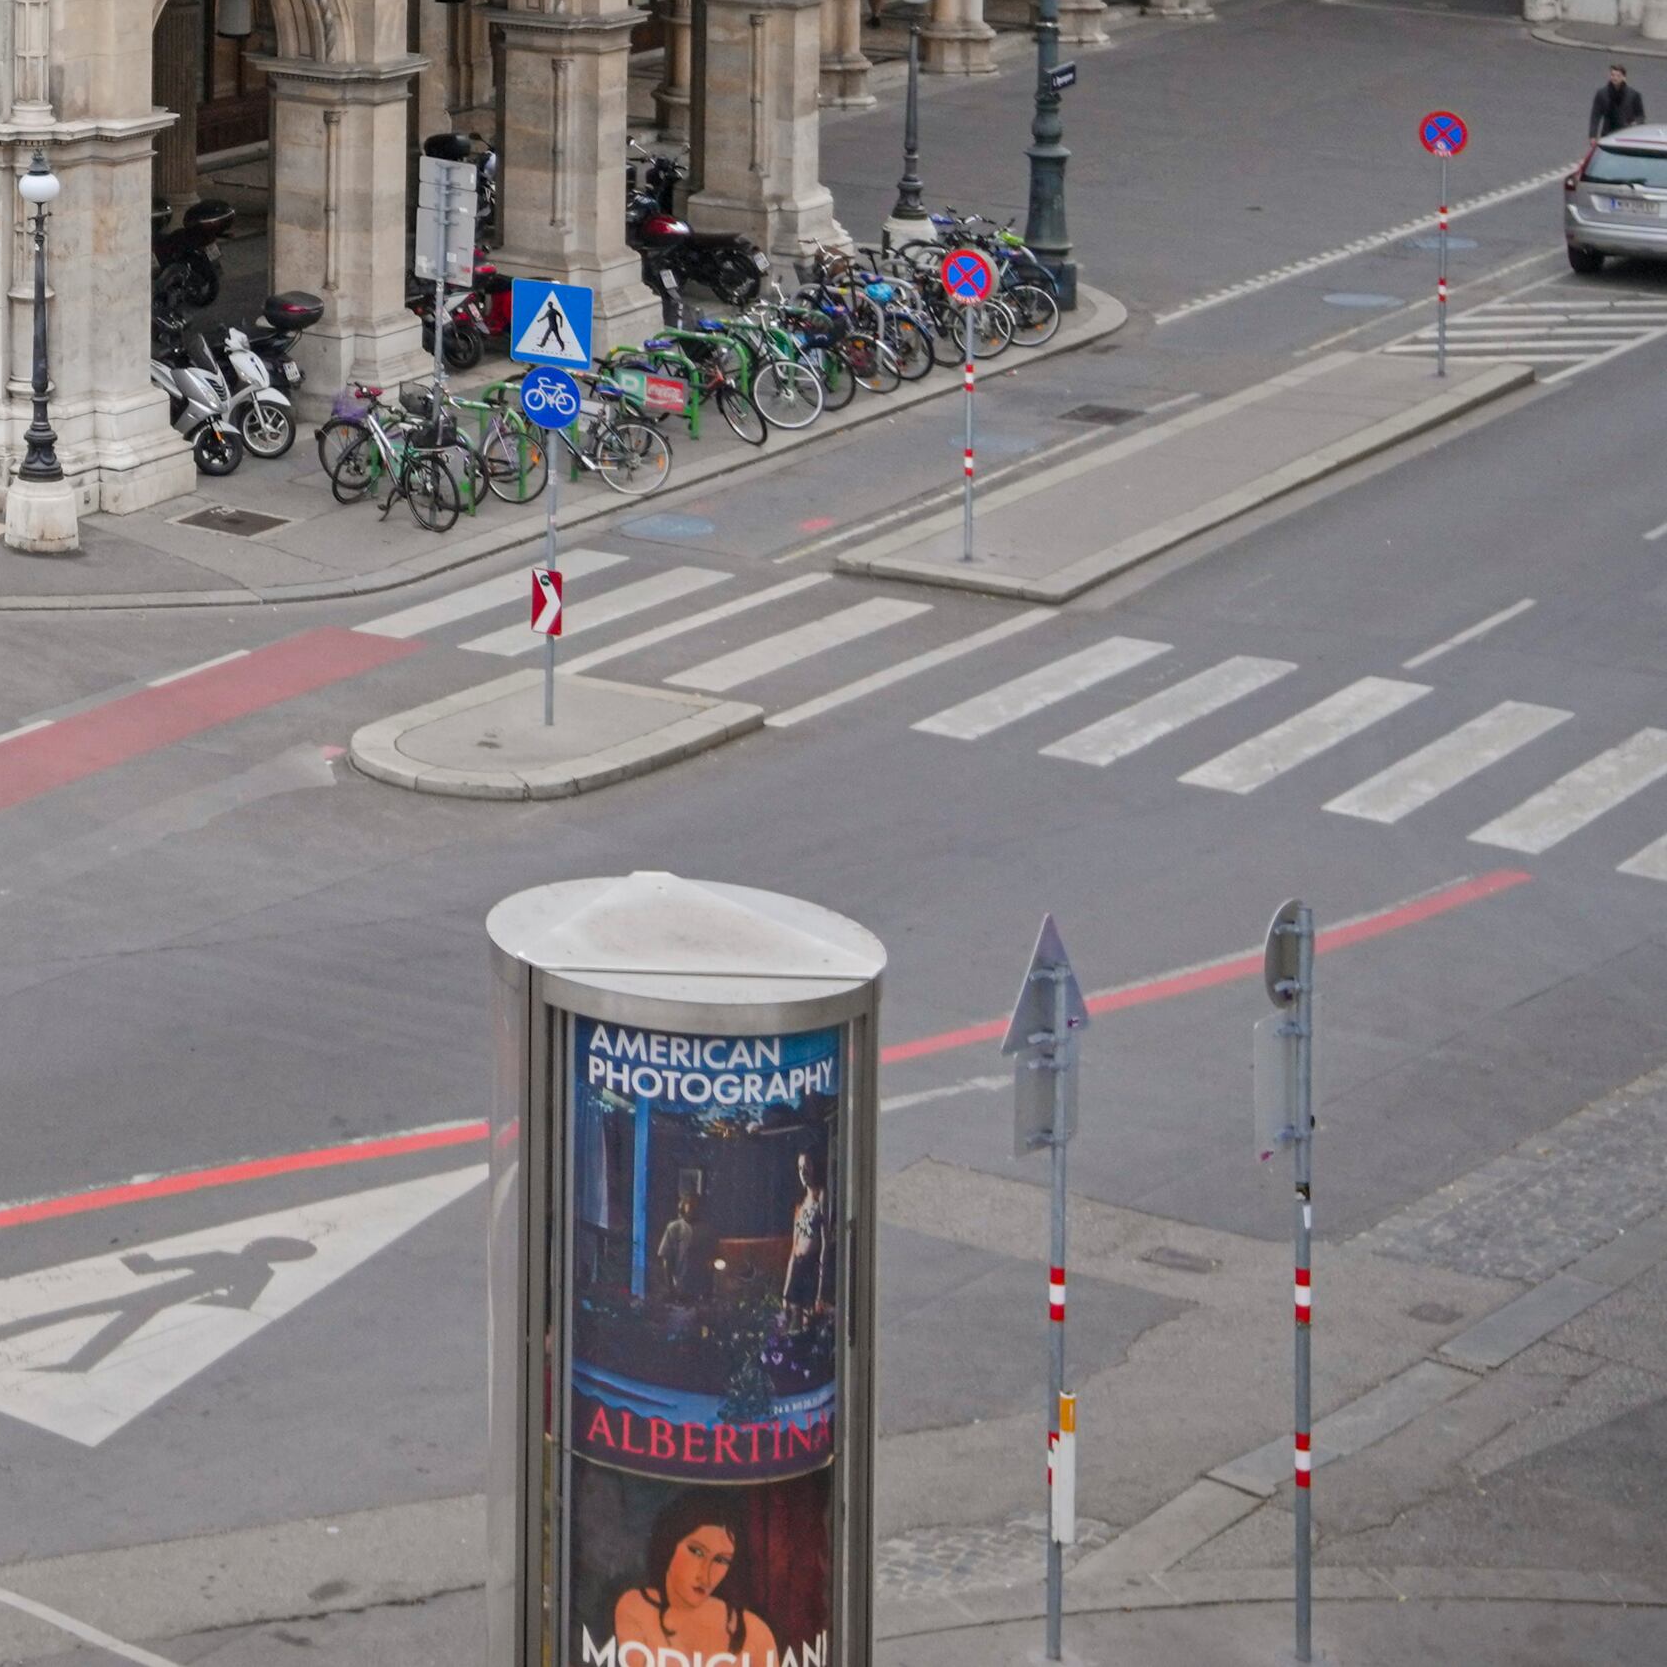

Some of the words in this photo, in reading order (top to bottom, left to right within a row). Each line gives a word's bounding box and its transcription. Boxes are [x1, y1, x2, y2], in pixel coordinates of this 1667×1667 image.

[589, 1024, 780, 1070] AMERICAN
[588, 1054, 833, 1105] PHOTOGRAPHY
[587, 1405, 832, 1464] ALBERTINA
